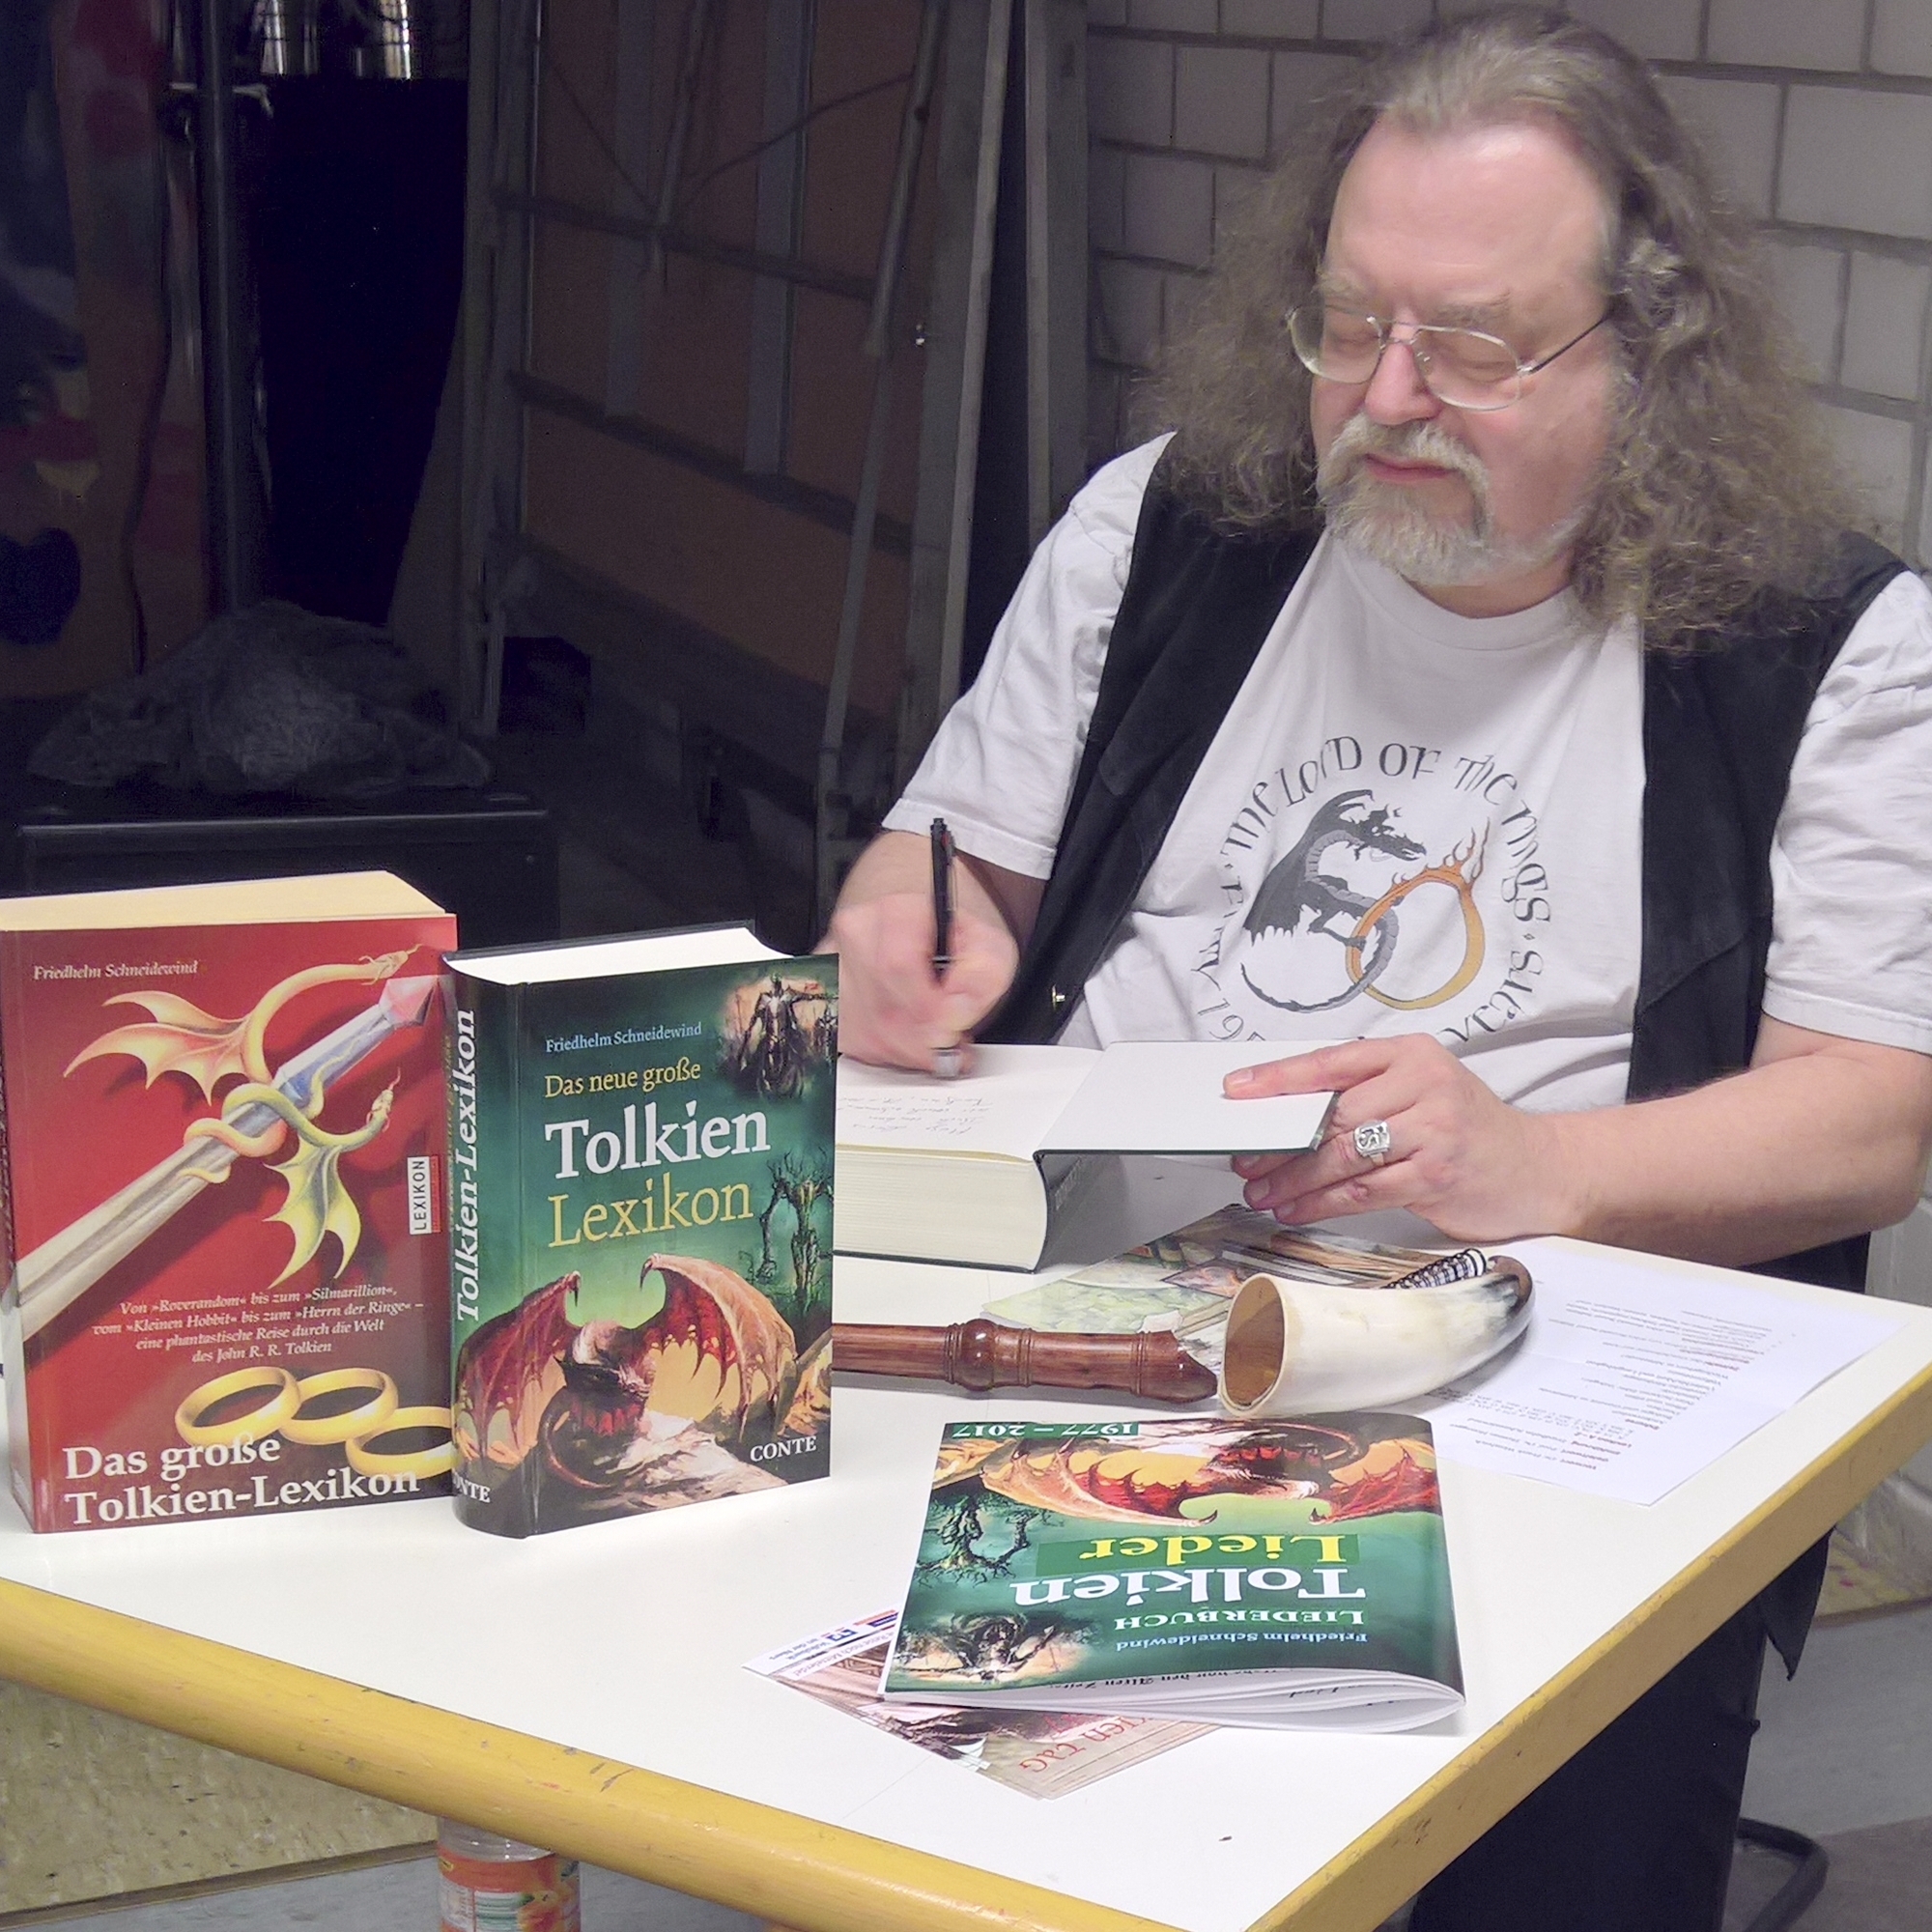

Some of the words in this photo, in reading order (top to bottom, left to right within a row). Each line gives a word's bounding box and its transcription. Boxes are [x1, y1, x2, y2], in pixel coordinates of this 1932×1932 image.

[1378, 742, 1442, 780] OF
[33, 964, 101, 981] Friedhelm
[104, 959, 199, 979] Schneidewind
[545, 1034, 613, 1054] Friedhelm
[613, 1021, 703, 1046] Schneidewind
[544, 1074, 584, 1098] Das
[589, 1069, 639, 1094] neue
[642, 1056, 702, 1092] große
[545, 1100, 772, 1180] Tolkien
[452, 1009, 480, 1321] Tolkien-Lexikon
[412, 1160, 427, 1231] LEXIKON
[548, 1172, 754, 1248] Lexikon
[93, 1323, 123, 1335] vom
[241, 1310, 260, 1323] bis
[263, 1310, 292, 1322] zum
[344, 1301, 364, 1316] der
[119, 1301, 148, 1315] Von
[250, 1292, 270, 1304] bis
[271, 1293, 300, 1303] zum
[135, 1336, 162, 1350] eine
[165, 1328, 253, 1351] phantastische
[256, 1325, 290, 1340] Reise
[292, 1321, 330, 1337] durch
[331, 1320, 352, 1334] die
[353, 1318, 385, 1332] Welt
[191, 1349, 213, 1363] des
[214, 1346, 246, 1364] John
[248, 1345, 266, 1358] R.
[267, 1343, 283, 1357] R.
[285, 1341, 333, 1356] Tolkien
[952, 1422, 1026, 1439] 2017
[1061, 1423, 1133, 1436] 1977
[62, 1445, 148, 1480] Das
[159, 1432, 282, 1482] große
[749, 1435, 818, 1463] CONTE
[63, 1467, 421, 1526] Tolkien-Lexikon
[1078, 1533, 1348, 1567] Lieder
[1009, 1567, 1367, 1607] Tolkien
[1116, 1632, 1259, 1652] Schneidewind
[1263, 1632, 1368, 1643] Friedhelm
